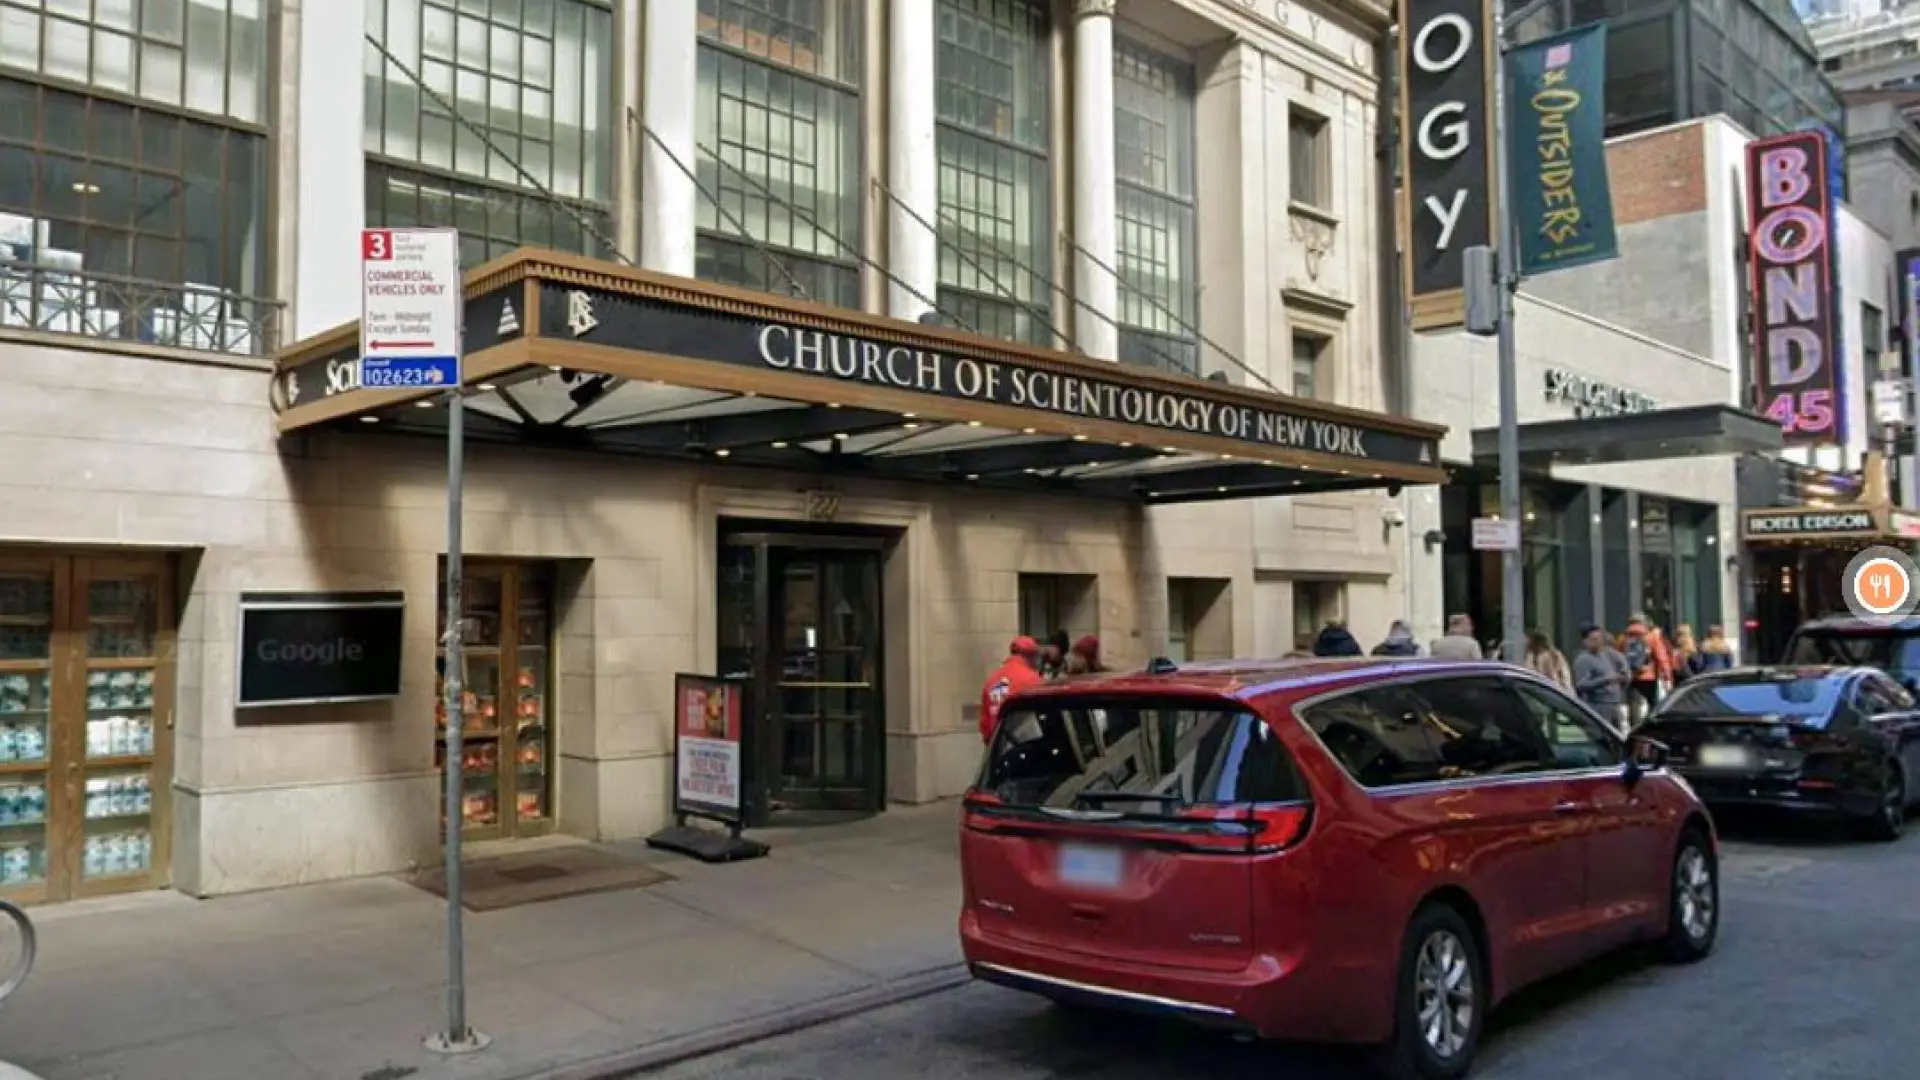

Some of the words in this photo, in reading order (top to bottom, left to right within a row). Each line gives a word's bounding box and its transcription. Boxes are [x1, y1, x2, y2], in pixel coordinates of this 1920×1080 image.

[1413, 12, 1473, 250] OGY
[1531, 88, 1581, 244] OUTSIDERS
[368, 233, 387, 258] 3
[367, 270, 434, 282] COMMERCIAL
[1755, 147, 1824, 386] BOND
[367, 284, 417, 295] VEHICLES
[419, 284, 444, 295] ONLY
[365, 368, 422, 385] 102623
[758, 324, 942, 391] CHURCH
[954, 358, 1000, 400] OF
[1011, 367, 1214, 433] SCIENTOLOGY
[1219, 405, 1254, 439] OF
[1256, 410, 1308, 447] NEW
[1311, 420, 1368, 458] YORK
[1765, 388, 1834, 433] 45
[1751, 515, 1800, 532] HOTEL
